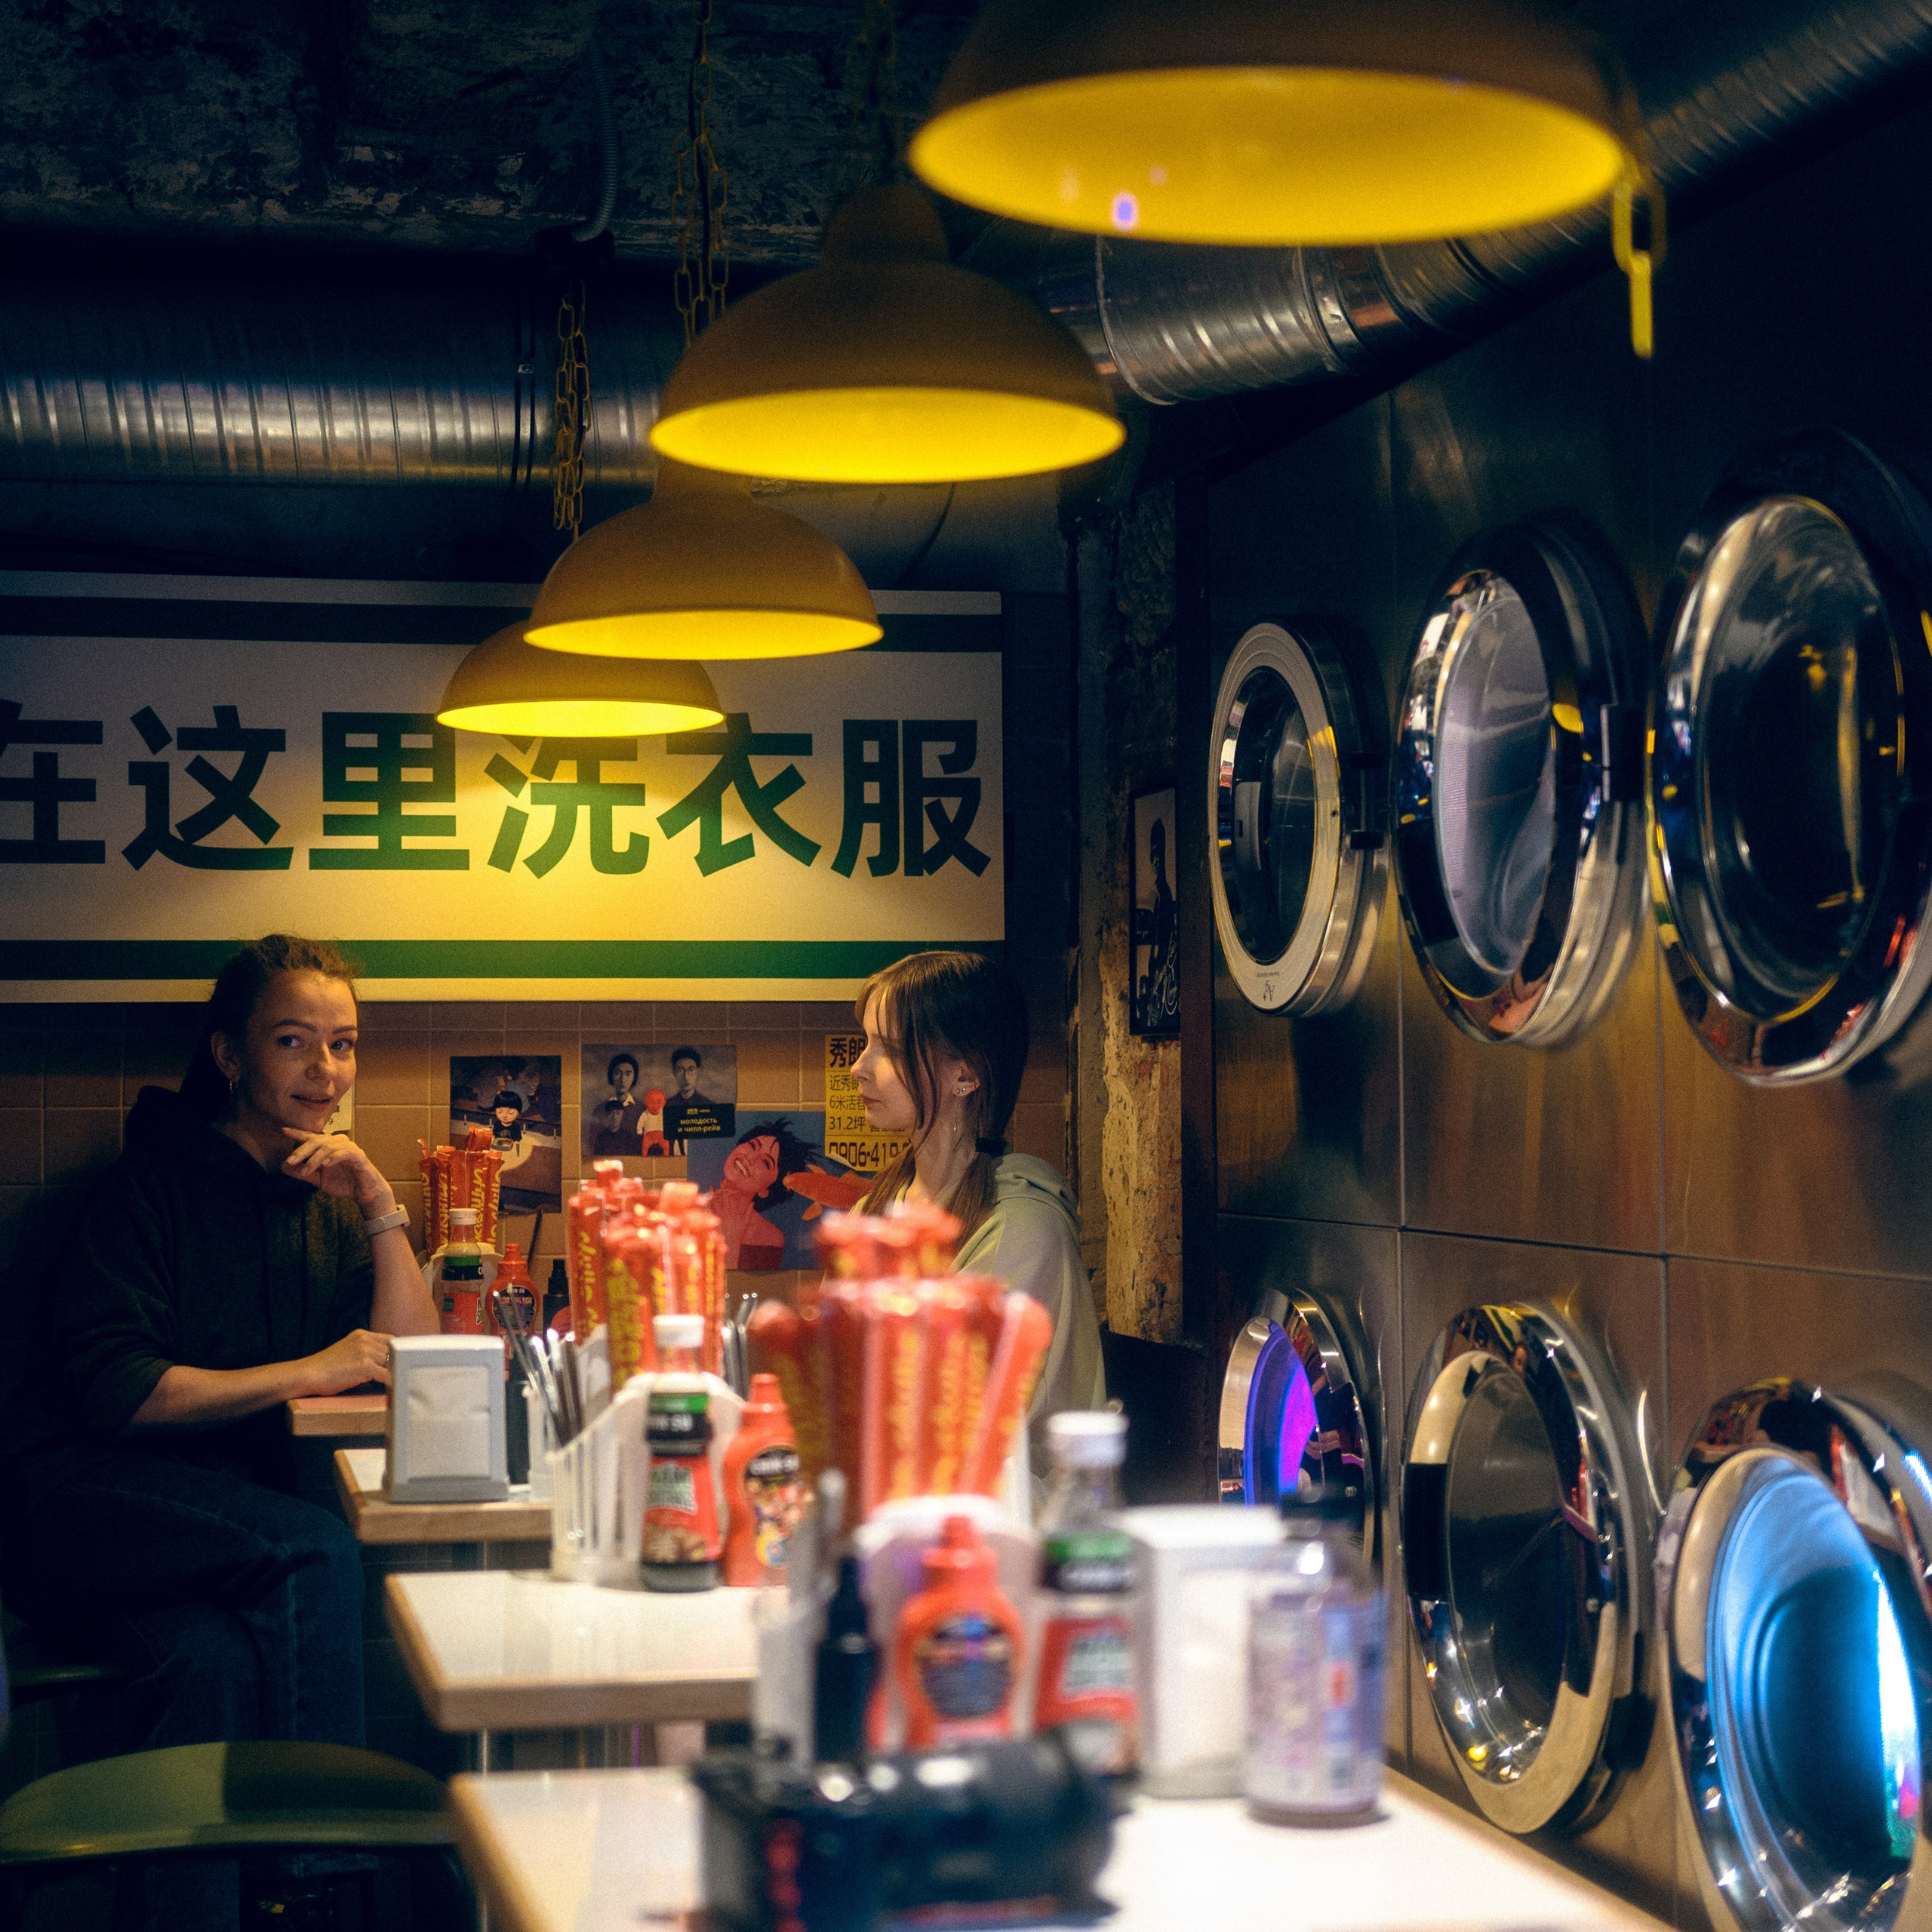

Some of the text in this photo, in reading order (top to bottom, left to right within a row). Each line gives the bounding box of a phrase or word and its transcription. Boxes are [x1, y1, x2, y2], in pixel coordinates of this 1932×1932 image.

[0, 699, 991, 878] 在这里洗衣服
[680, 1118, 718, 1126] молодость
